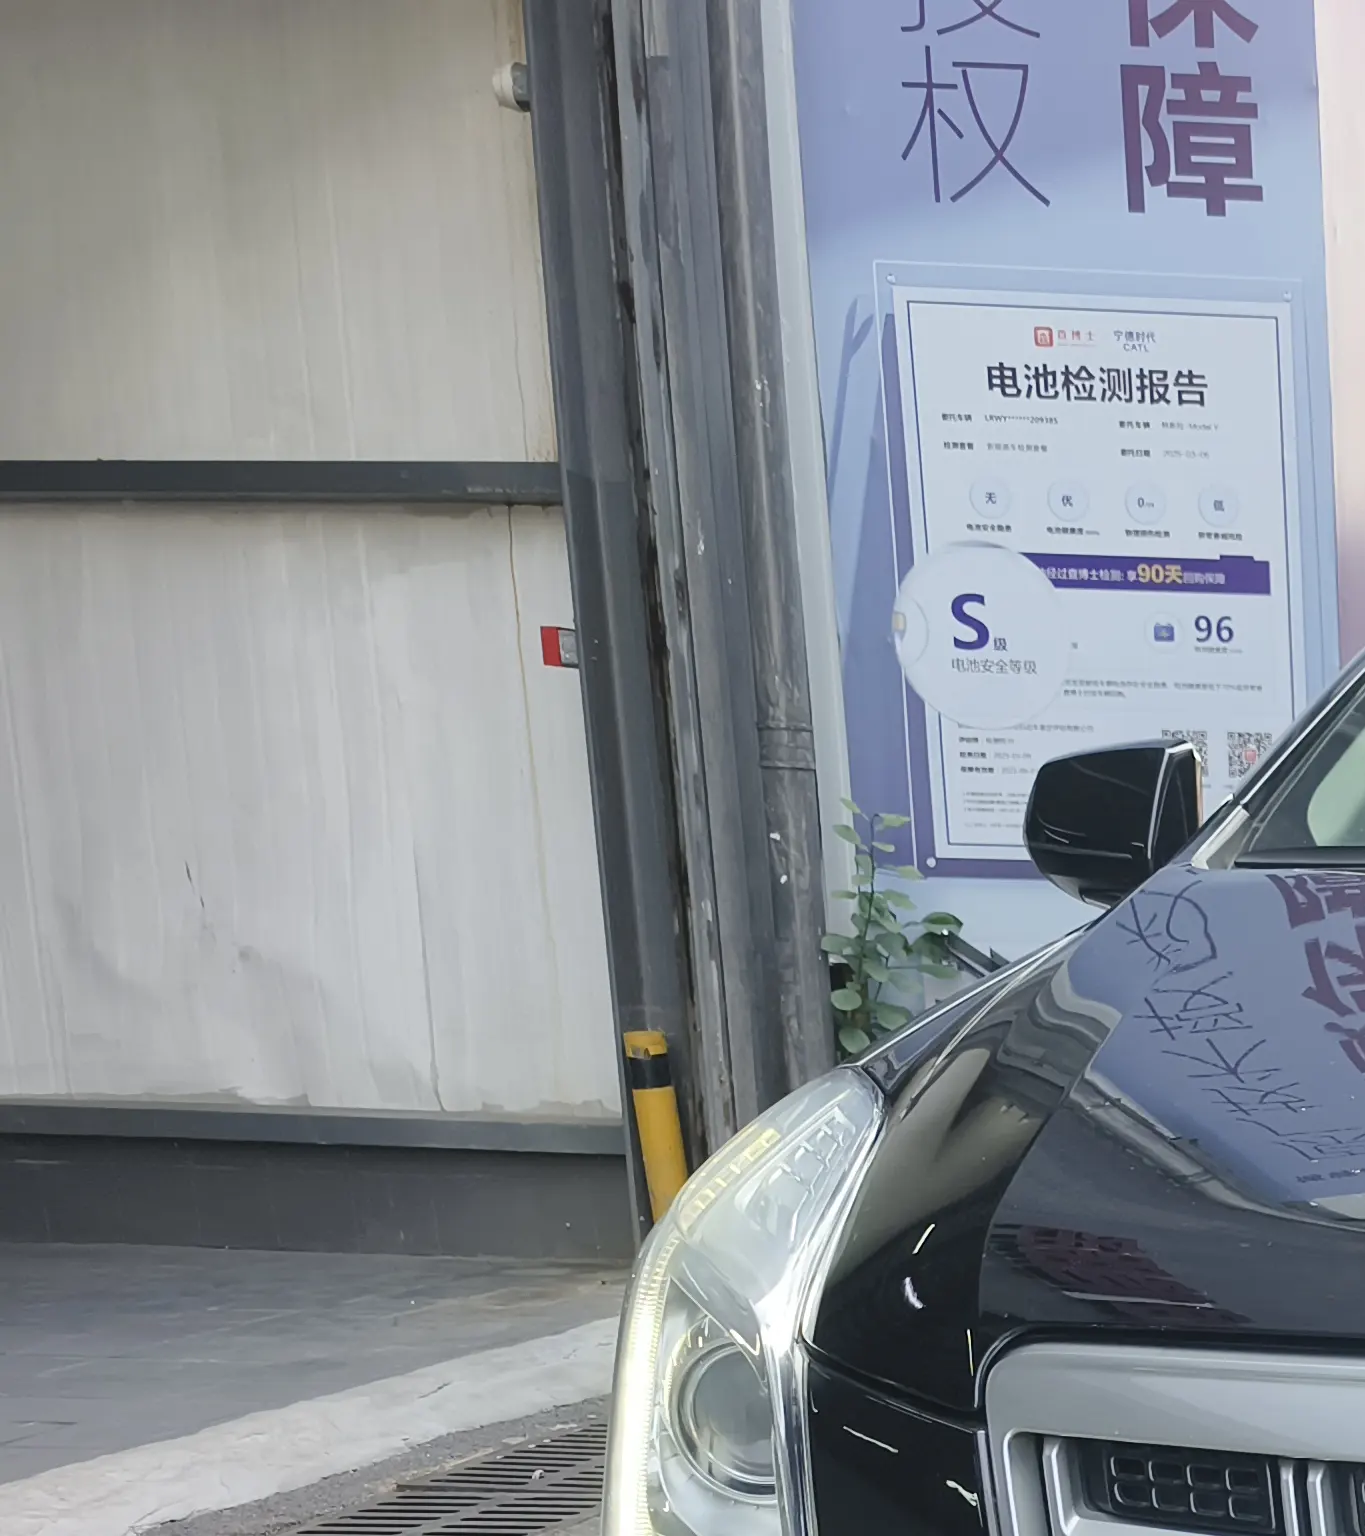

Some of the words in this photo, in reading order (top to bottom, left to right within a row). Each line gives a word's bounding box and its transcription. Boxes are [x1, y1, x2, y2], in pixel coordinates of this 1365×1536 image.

[900, 0, 1051, 208] 权
[1123, 343, 1150, 353] CATL
[986, 361, 1208, 407] 电池检测报告
[985, 492, 997, 505] 无
[950, 593, 990, 651] S
[993, 638, 1008, 653] 级
[1194, 615, 1235, 643] 96
[951, 658, 1038, 676] 电池安全等级
